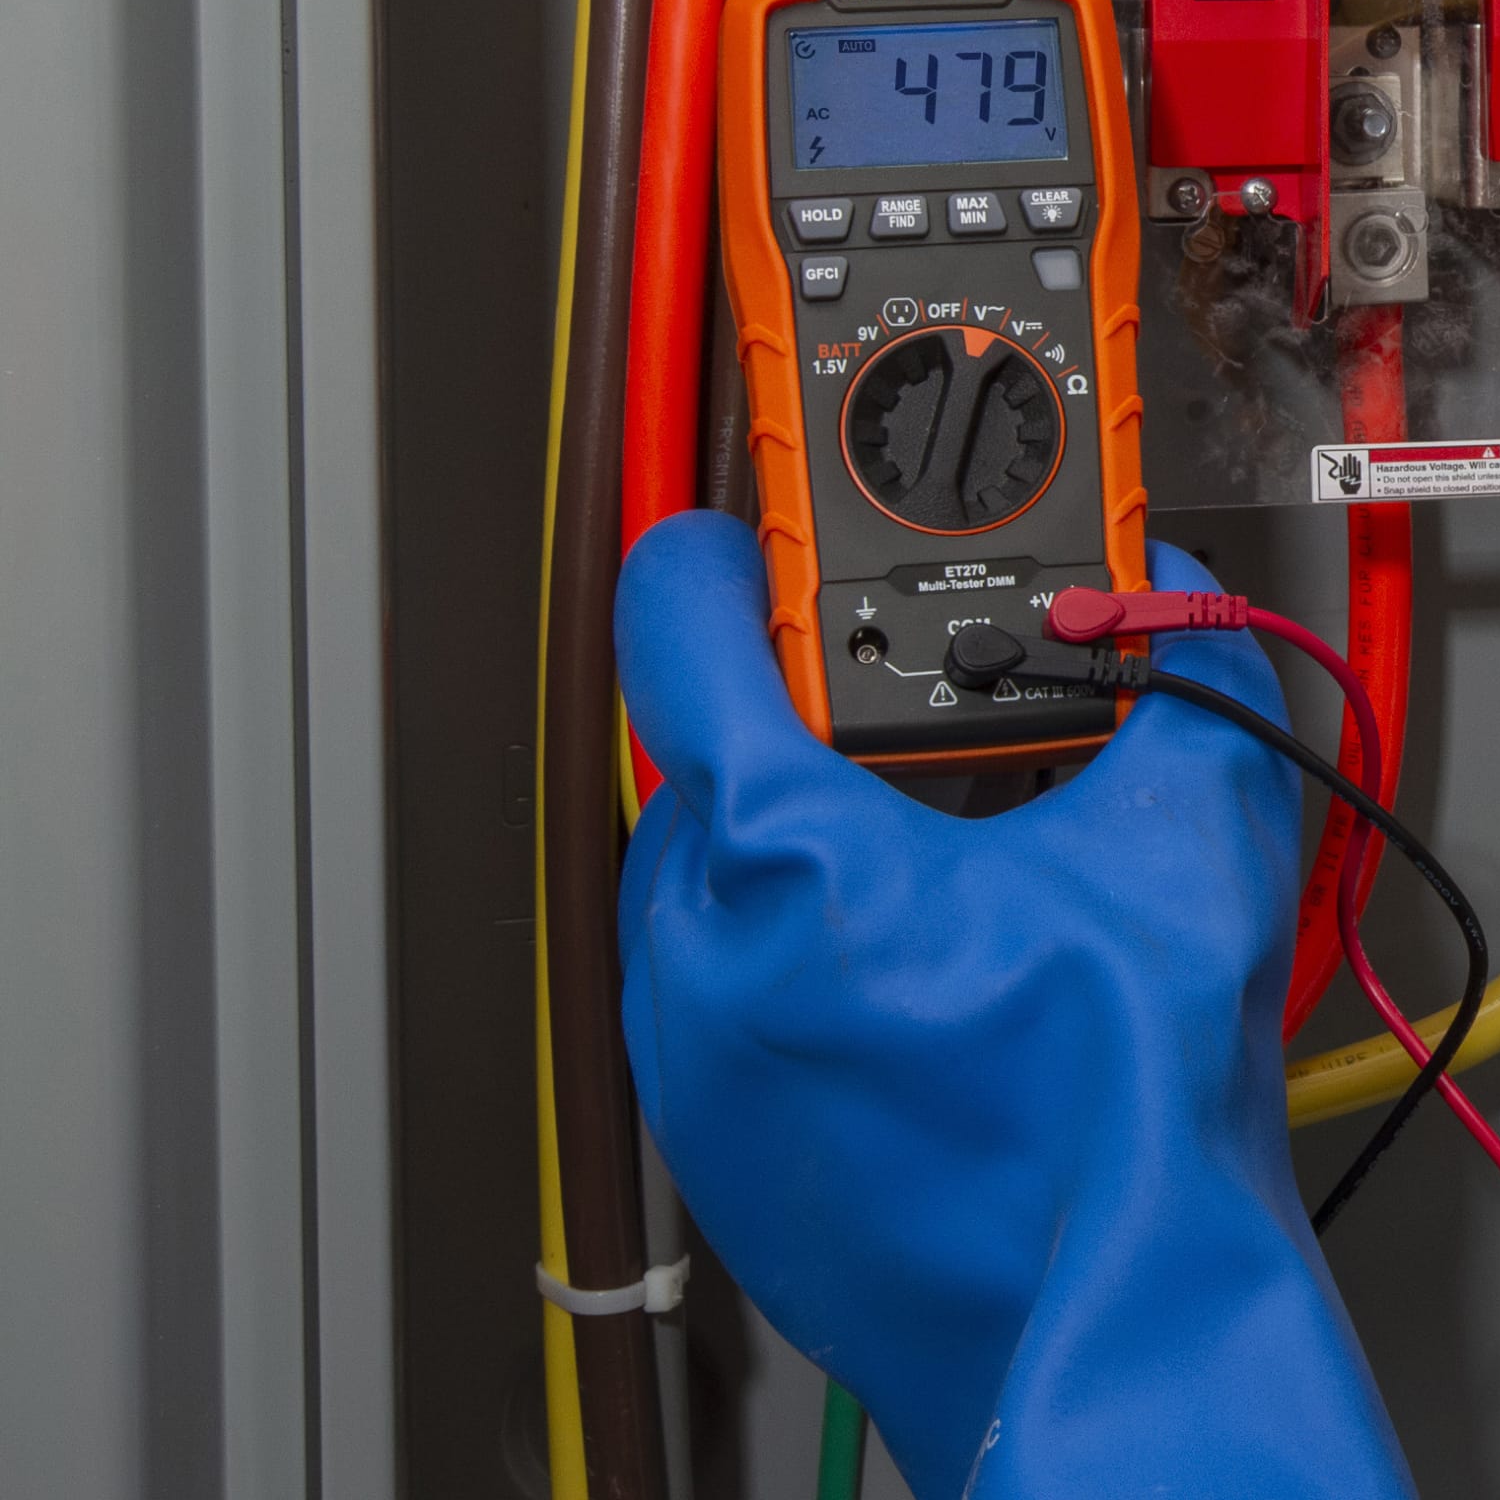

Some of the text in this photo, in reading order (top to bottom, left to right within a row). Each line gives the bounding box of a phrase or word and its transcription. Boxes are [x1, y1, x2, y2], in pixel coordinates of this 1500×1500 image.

[842, 40, 874, 52] AUTO
[894, 50, 1047, 126] 479
[805, 107, 831, 120] AC
[1044, 127, 1057, 141] V
[956, 196, 989, 210] MAX
[1031, 191, 1069, 203] CLEAR
[880, 199, 921, 213] RANGE
[801, 208, 843, 223] HOLD
[889, 215, 916, 229] FIND
[960, 211, 987, 224] MIN
[805, 267, 839, 281] GFCI
[927, 303, 960, 319] OFF
[857, 326, 879, 341] 9V
[818, 343, 862, 358] BATT
[812, 359, 848, 375] 1.5V
[1376, 463, 1427, 473] Hazardous
[1469, 460, 1487, 470] Will
[1383, 475, 1396, 484] Do
[1397, 474, 1411, 483] not
[1411, 475, 1433, 485] open
[1434, 474, 1450, 482] this
[1450, 473, 1476, 481] shield
[1383, 486, 1406, 496] Snap
[1406, 484, 1432, 493] shield
[1432, 485, 1442, 493] to
[1442, 483, 1470, 492] closed
[944, 564, 987, 578] ET270
[917, 575, 1016, 593] Multi-Tester DMM
[1024, 688, 1049, 700] CAT
[1051, 686, 1065, 699] III
